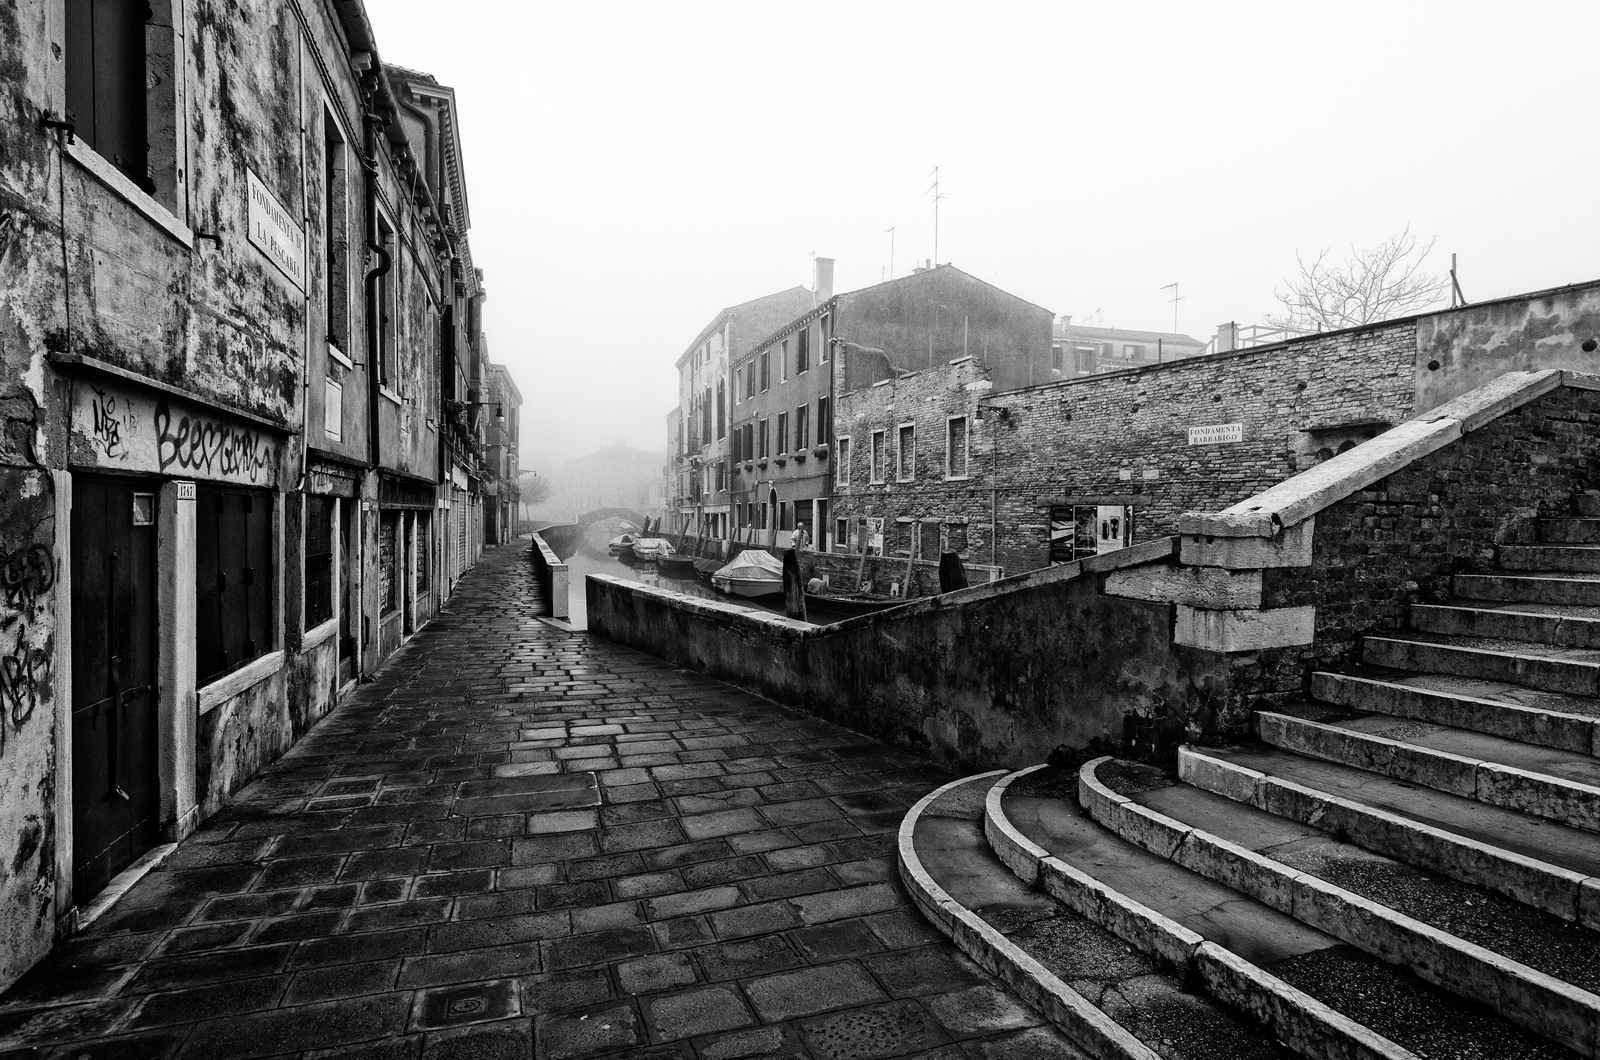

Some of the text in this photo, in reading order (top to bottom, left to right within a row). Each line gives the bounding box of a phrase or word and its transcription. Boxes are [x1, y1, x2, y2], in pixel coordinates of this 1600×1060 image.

[252, 182, 294, 242] FONDAMENTA
[257, 221, 300, 279] LA PESCARIA
[1190, 426, 1241, 435] FONDAMENTA
[1193, 435, 1238, 443] BARBARIGO
[180, 486, 193, 497] 1747
